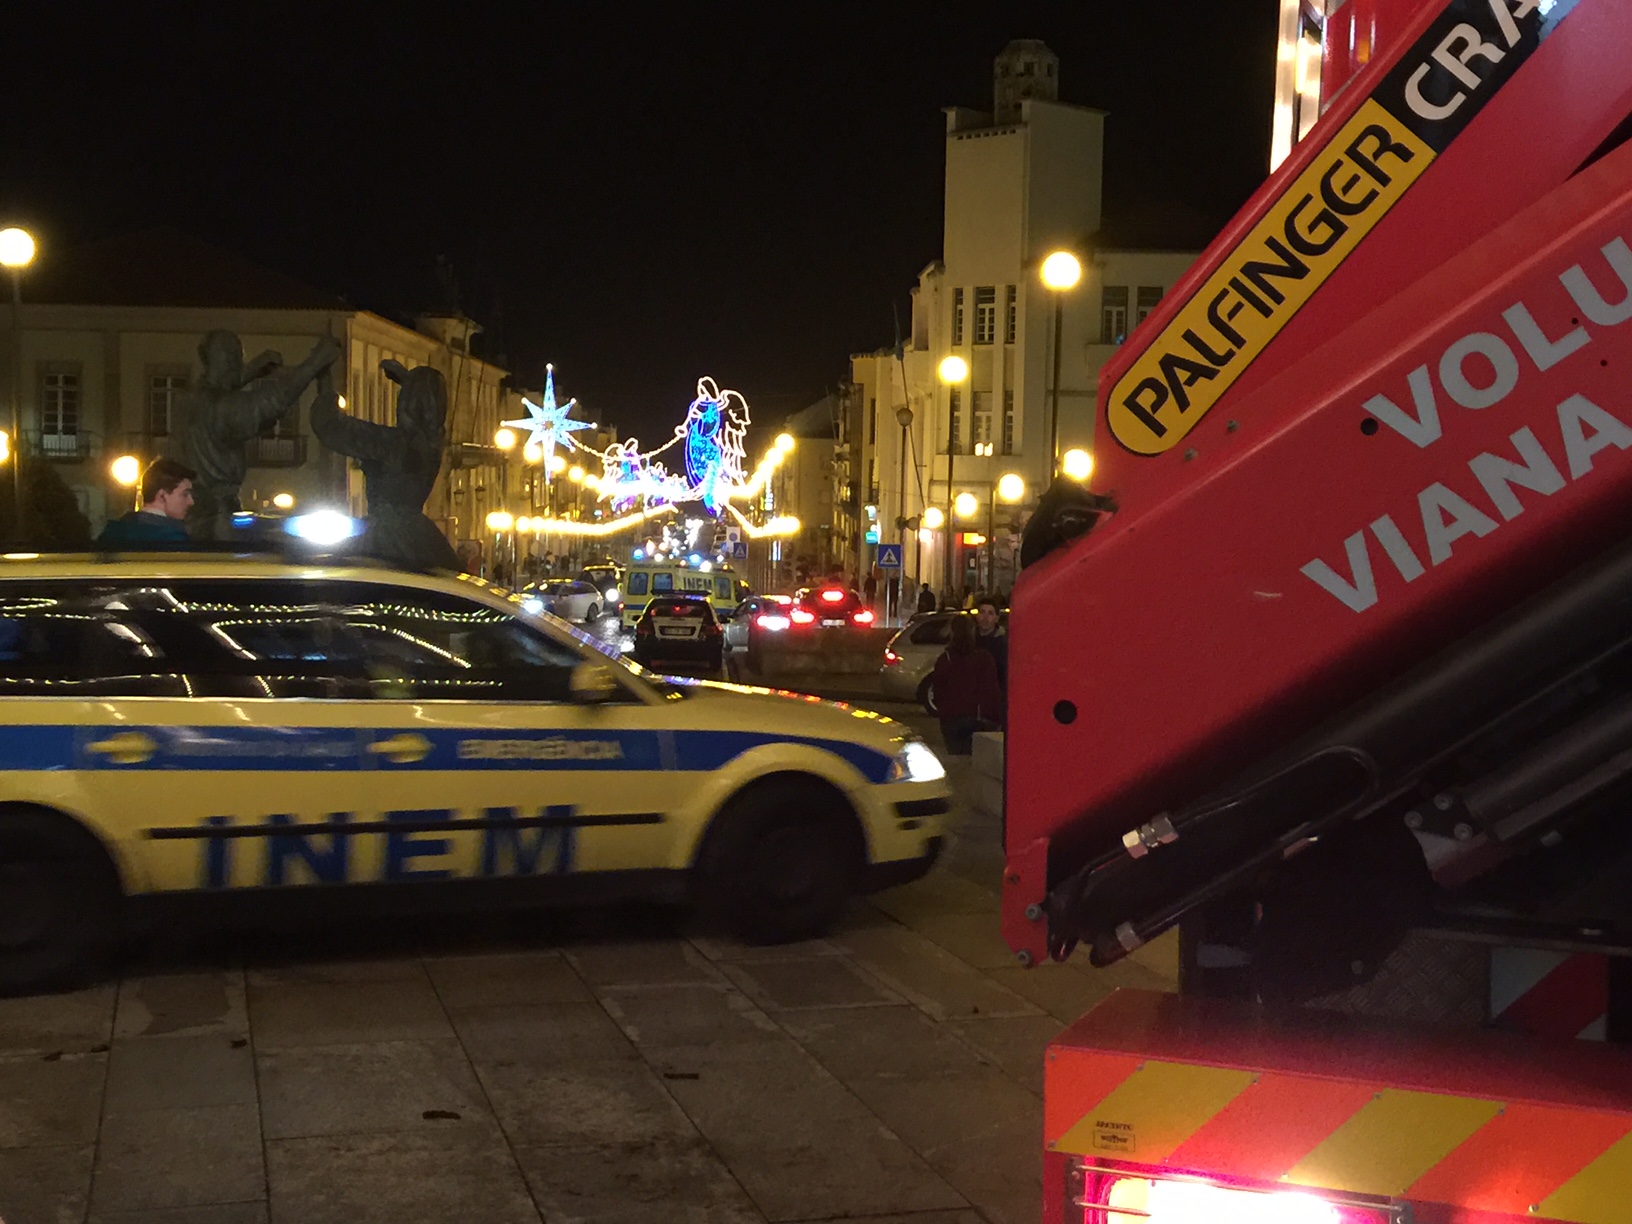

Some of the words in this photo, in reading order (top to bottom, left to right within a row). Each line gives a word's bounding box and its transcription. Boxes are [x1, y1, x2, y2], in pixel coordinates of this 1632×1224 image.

[1123, 124, 1414, 438] PALFINGER
[1363, 238, 1632, 448] VOLU
[1300, 393, 1632, 613] VIANA
[203, 804, 577, 889] INEM
